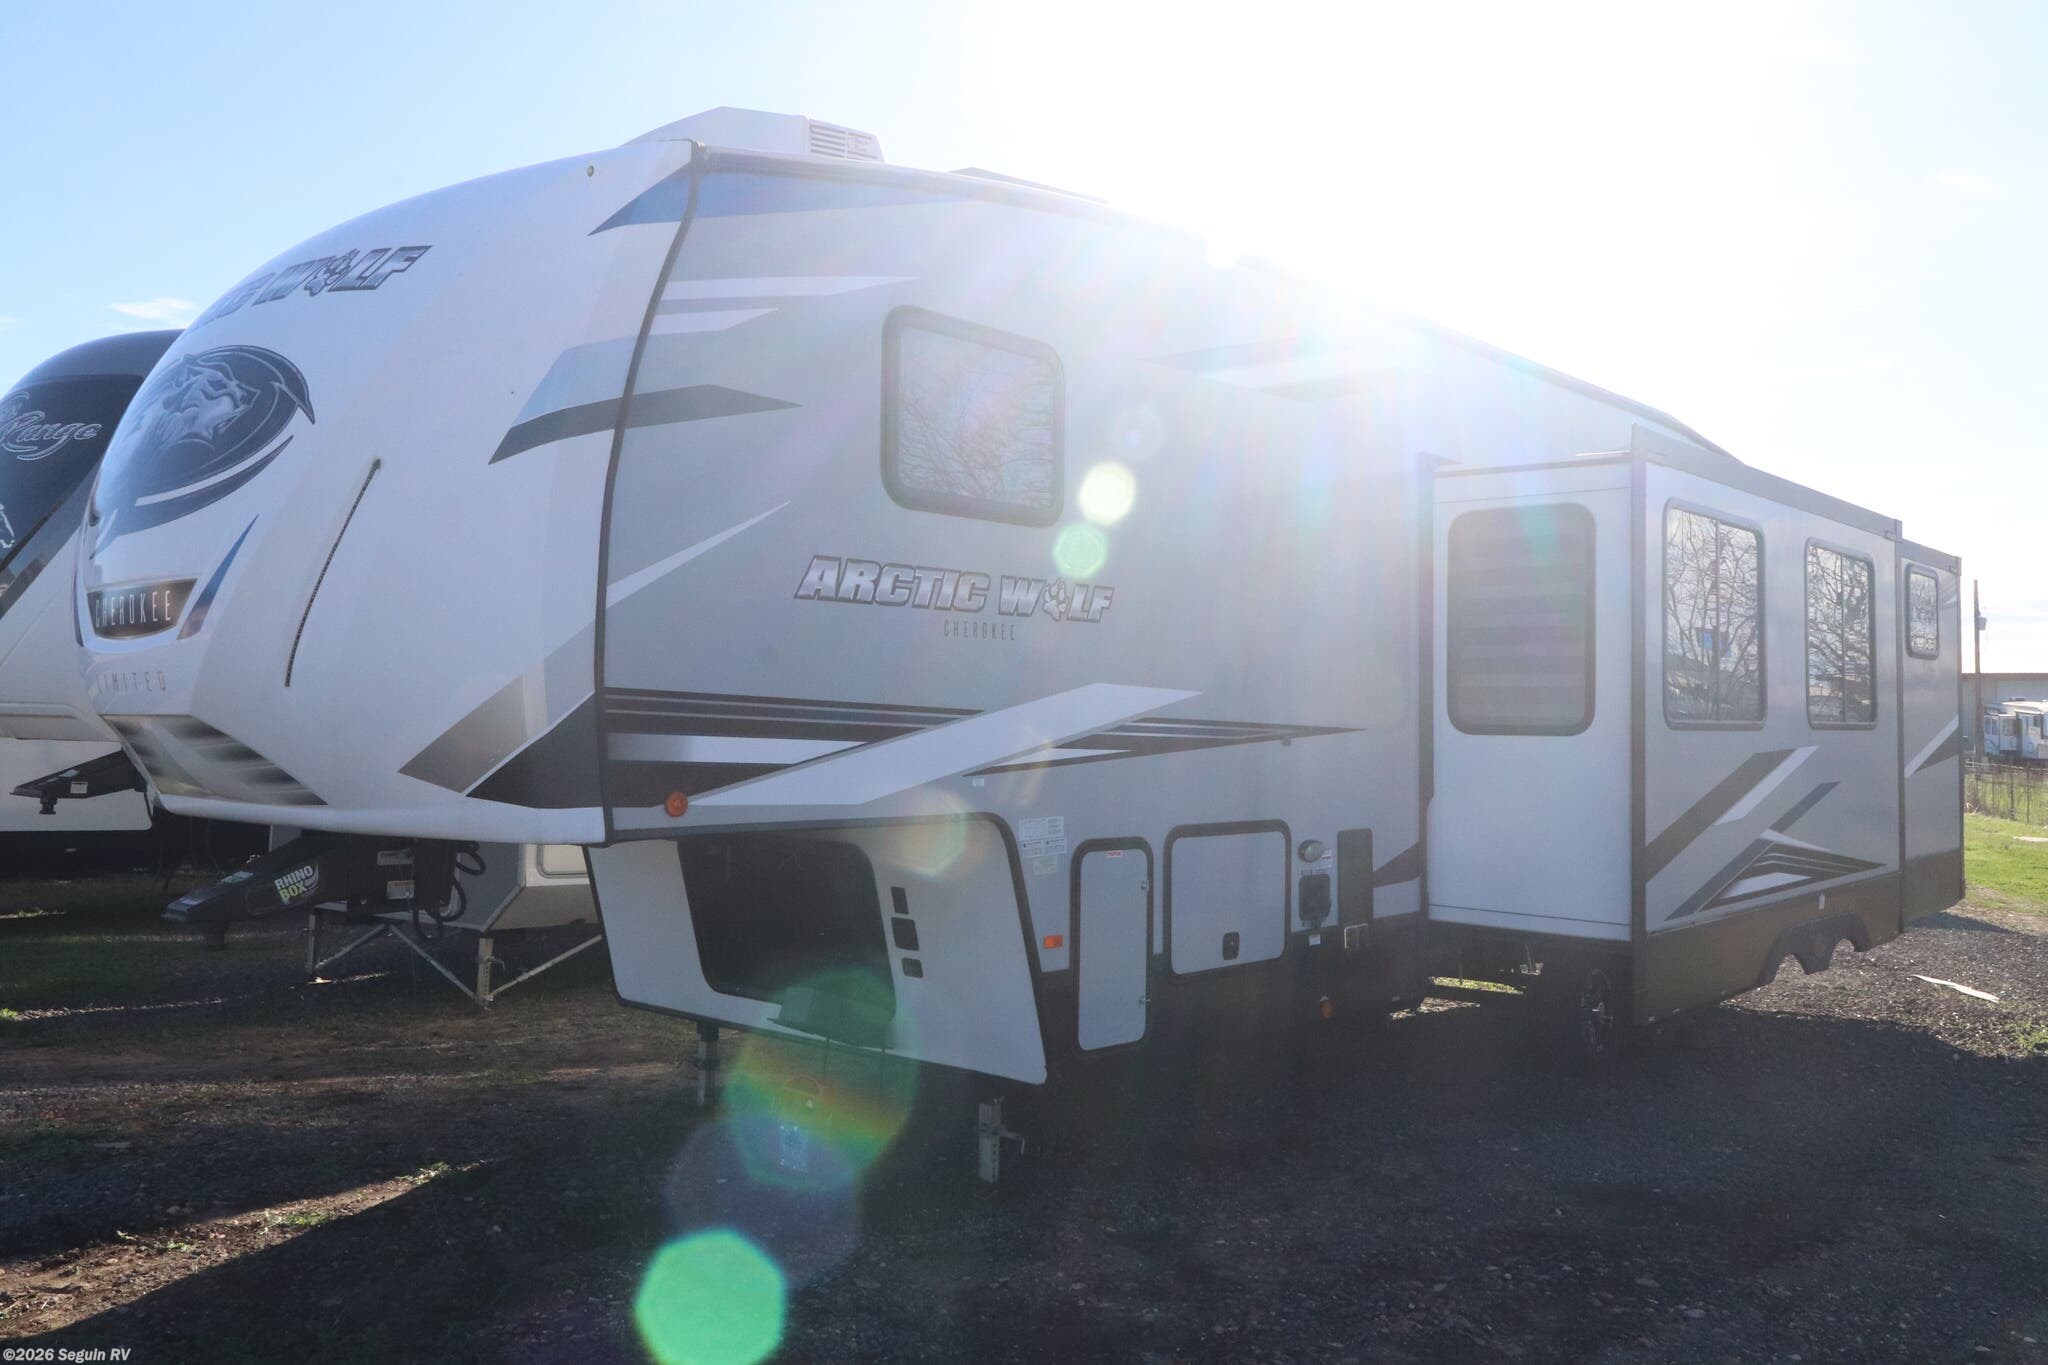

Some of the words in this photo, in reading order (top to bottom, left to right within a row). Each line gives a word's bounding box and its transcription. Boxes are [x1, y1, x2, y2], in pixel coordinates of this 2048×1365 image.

[794, 554, 991, 613] ARCTIC
[95, 590, 171, 628] CHEROKEE
[943, 619, 1016, 641] CHEROKEE
[274, 865, 314, 890] RHINO
[279, 880, 308, 902] BOX
